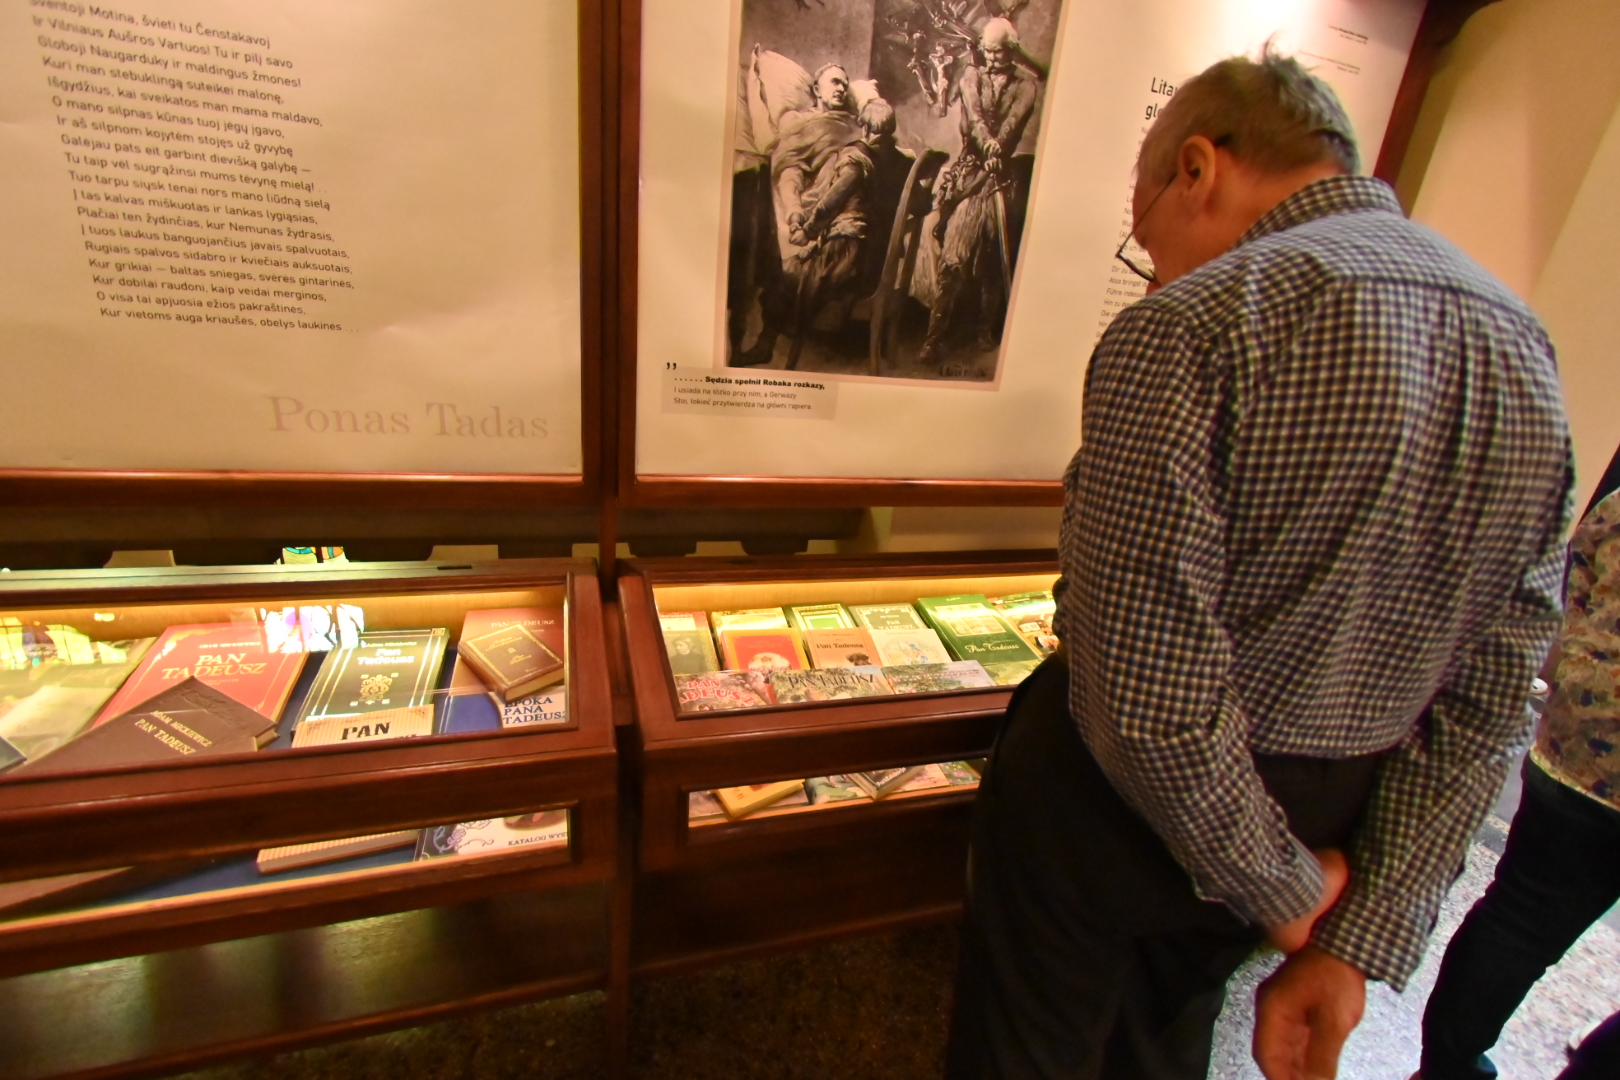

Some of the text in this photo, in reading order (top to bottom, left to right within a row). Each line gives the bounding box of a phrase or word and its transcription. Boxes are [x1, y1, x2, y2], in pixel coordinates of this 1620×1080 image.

[49, 18, 104, 38] Vilniaus
[214, 45, 228, 58] Tu
[265, 57, 293, 69] savo
[179, 22, 193, 34] tu
[195, 22, 271, 50] Čenstakavoj
[37, 35, 87, 56] Globoji
[89, 44, 169, 70] Naugarduky
[185, 62, 249, 80] maldingus
[42, 56, 72, 70] Kuri
[75, 63, 106, 76] man
[186, 80, 234, 95] suteikei
[52, 95, 62, 107] O
[66, 100, 104, 113] mano
[107, 106, 154, 120] silpnas
[196, 117, 220, 132] tuoj
[117, 87, 137, 99] kai
[140, 92, 200, 108] sveikatos
[202, 101, 229, 112] man
[232, 105, 269, 118] mama
[56, 115, 67, 126] Ir
[91, 121, 142, 136] silpnom
[114, 142, 142, 154] pats
[144, 146, 160, 156] eit
[164, 149, 206, 162] garbint
[64, 152, 80, 164] Tu
[83, 155, 108, 170] taip
[199, 170, 237, 182] mums
[68, 170, 92, 183] Tuo
[94, 174, 130, 188] tarpu
[168, 182, 198, 194] tenai
[201, 187, 228, 198] nors
[231, 191, 264, 202] mano
[80, 190, 102, 201] tas
[104, 192, 146, 206] kalvas
[224, 205, 264, 218] lankas
[122, 212, 142, 222] ten
[206, 219, 226, 230] kur
[228, 221, 284, 236] Nemunas
[88, 225, 116, 237] tuos
[119, 228, 160, 241] laukus
[250, 242, 283, 252] javais
[84, 240, 131, 255] Rugiais
[133, 247, 180, 259] spalvos
[182, 251, 225, 263] sidabro
[88, 258, 110, 269] Kur
[114, 262, 152, 272] grikiai
[169, 265, 207, 277] baltas
[92, 274, 114, 286] Kur
[118, 277, 158, 289] dobilai
[210, 283, 235, 296] kaip
[237, 287, 270, 297] veidai
[96, 290, 106, 301] O
[109, 294, 134, 303] visa
[136, 294, 152, 304] tai
[154, 297, 204, 308] apjuosia
[100, 307, 122, 318] Kur
[125, 310, 172, 321] vietoms
[175, 314, 203, 324] auga
[259, 318, 296, 330] obelys
[763, 379, 792, 387] Robaka
[769, 390, 797, 400] Gerwazy
[264, 395, 550, 439] Ponas Tadas
[161, 662, 268, 680] TADEUSZ
[194, 652, 247, 667] PAN
[503, 705, 545, 717] PANA
[134, 718, 196, 756] PAN TADEUSZ
[340, 721, 392, 741] PAN
[508, 835, 547, 847] KATALOG
